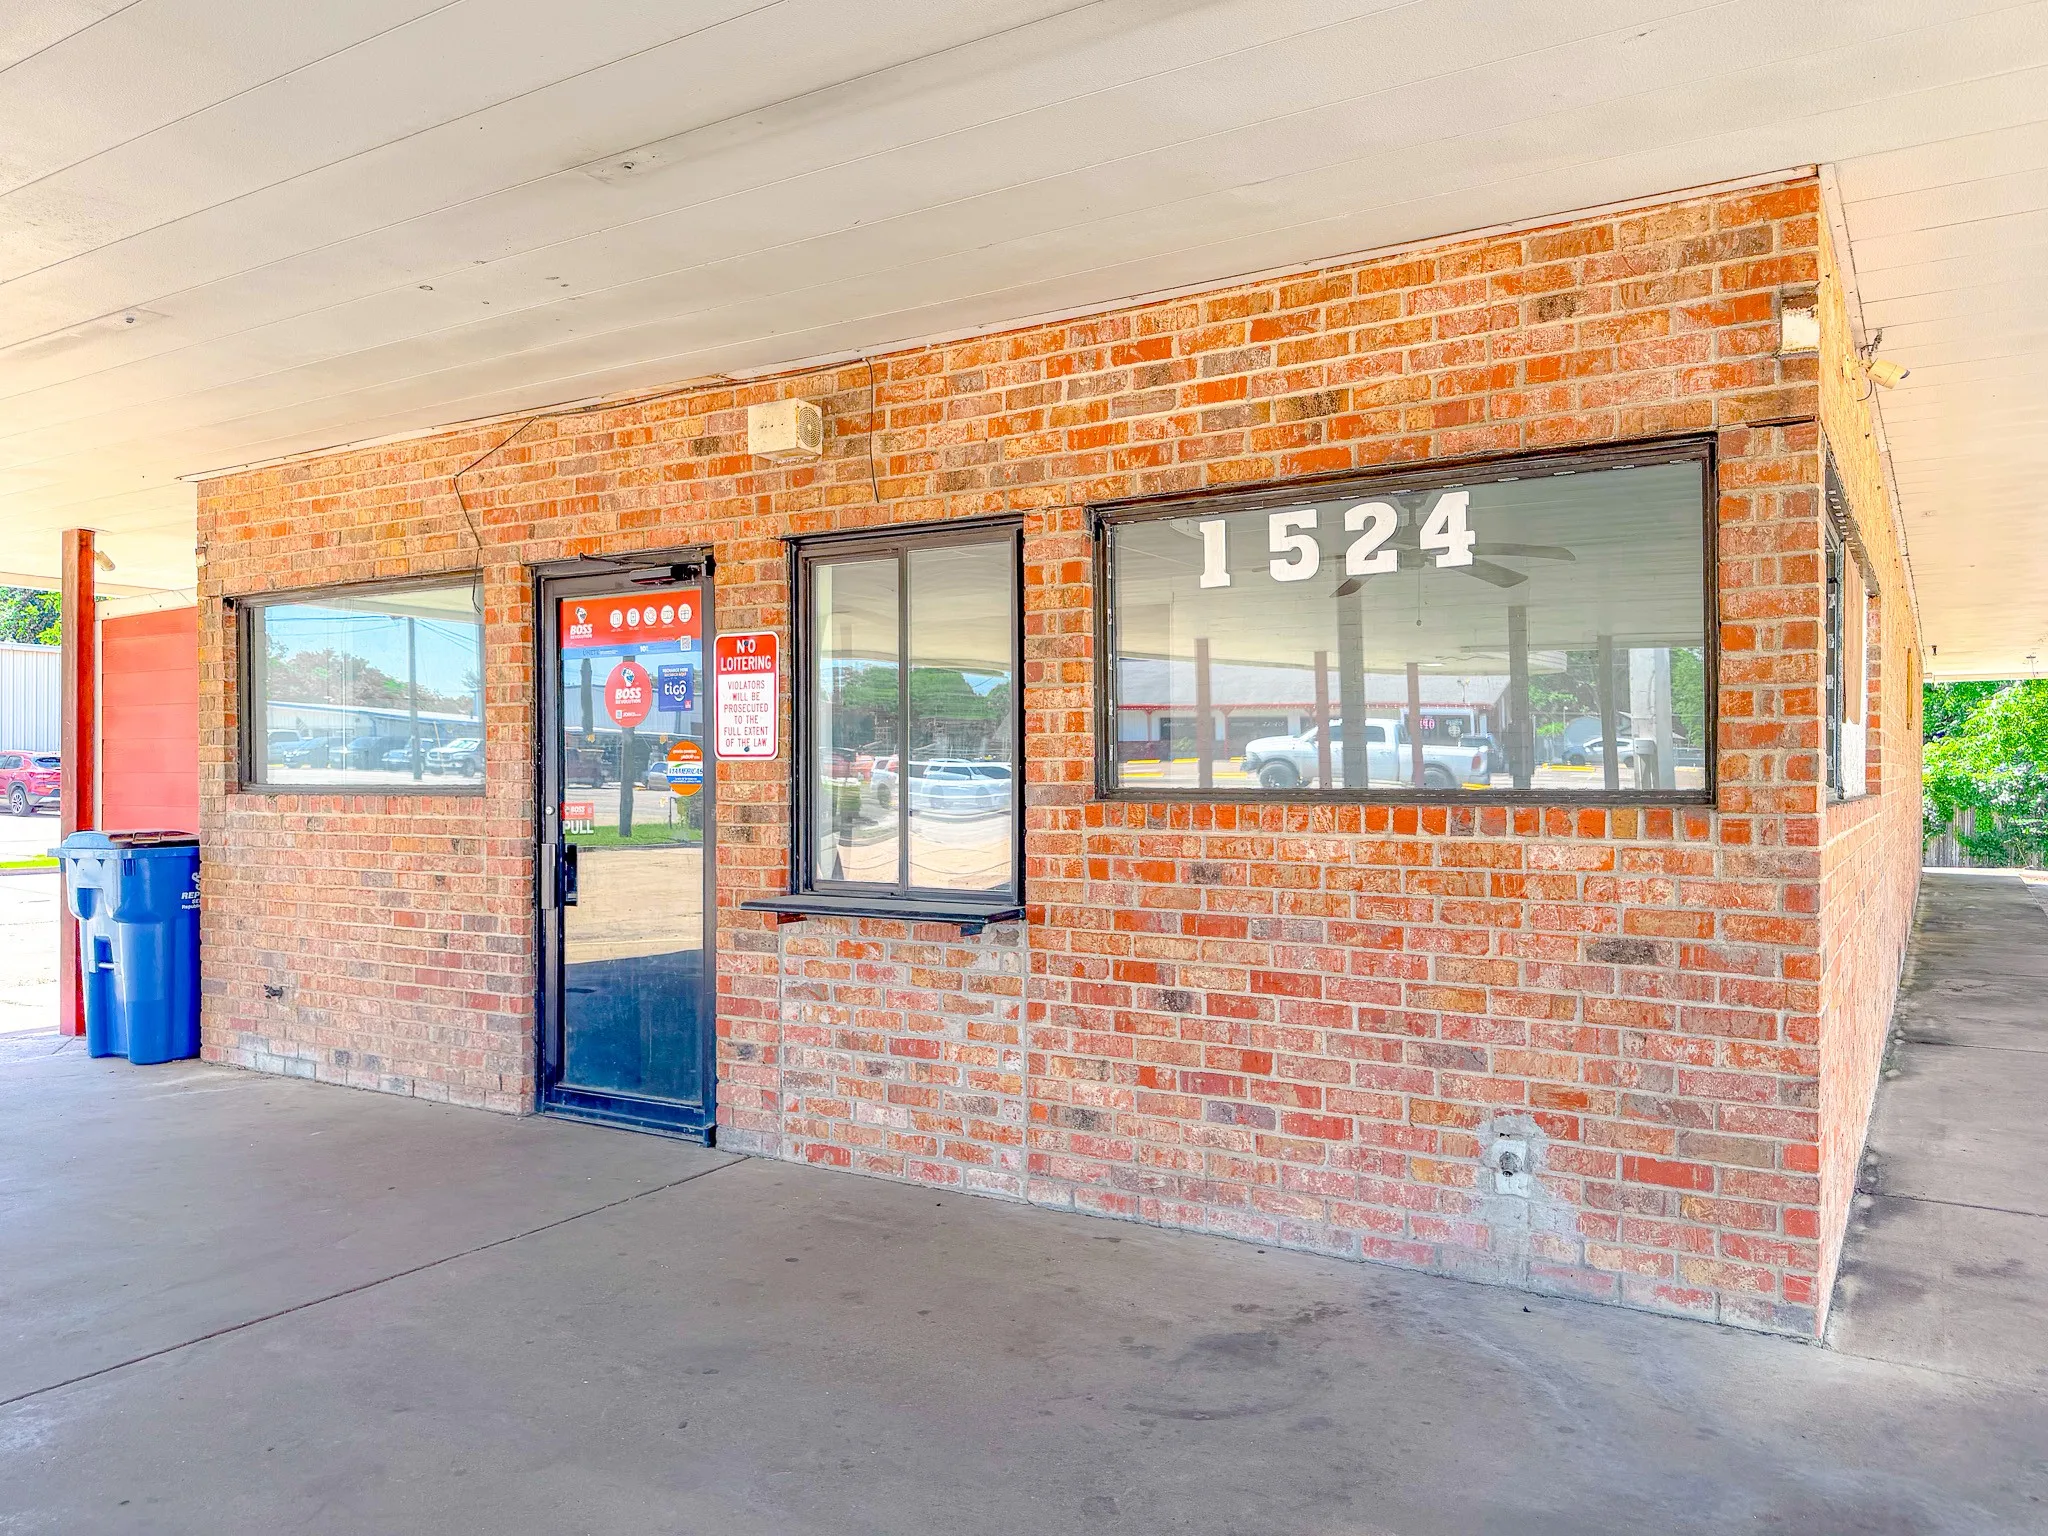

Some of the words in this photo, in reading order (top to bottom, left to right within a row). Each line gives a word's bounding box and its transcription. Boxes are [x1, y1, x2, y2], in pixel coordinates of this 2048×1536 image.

[570, 624, 593, 635] BOSS
[736, 639, 756, 653] NO
[721, 655, 772, 672] LOITERING
[728, 680, 765, 690] VIOLATORS
[615, 687, 642, 699] BOSS
[732, 693, 748, 702] WILL
[751, 692, 761, 701] BE
[723, 703, 769, 714] PROSECUTED
[734, 715, 743, 725] TO
[746, 715, 759, 725] THE
[723, 727, 741, 736] FULL
[744, 726, 769, 736] EXTENT
[725, 738, 735, 748] OF
[738, 738, 750, 748] THE
[753, 737, 768, 747] LAW
[563, 820, 595, 835] PULL
